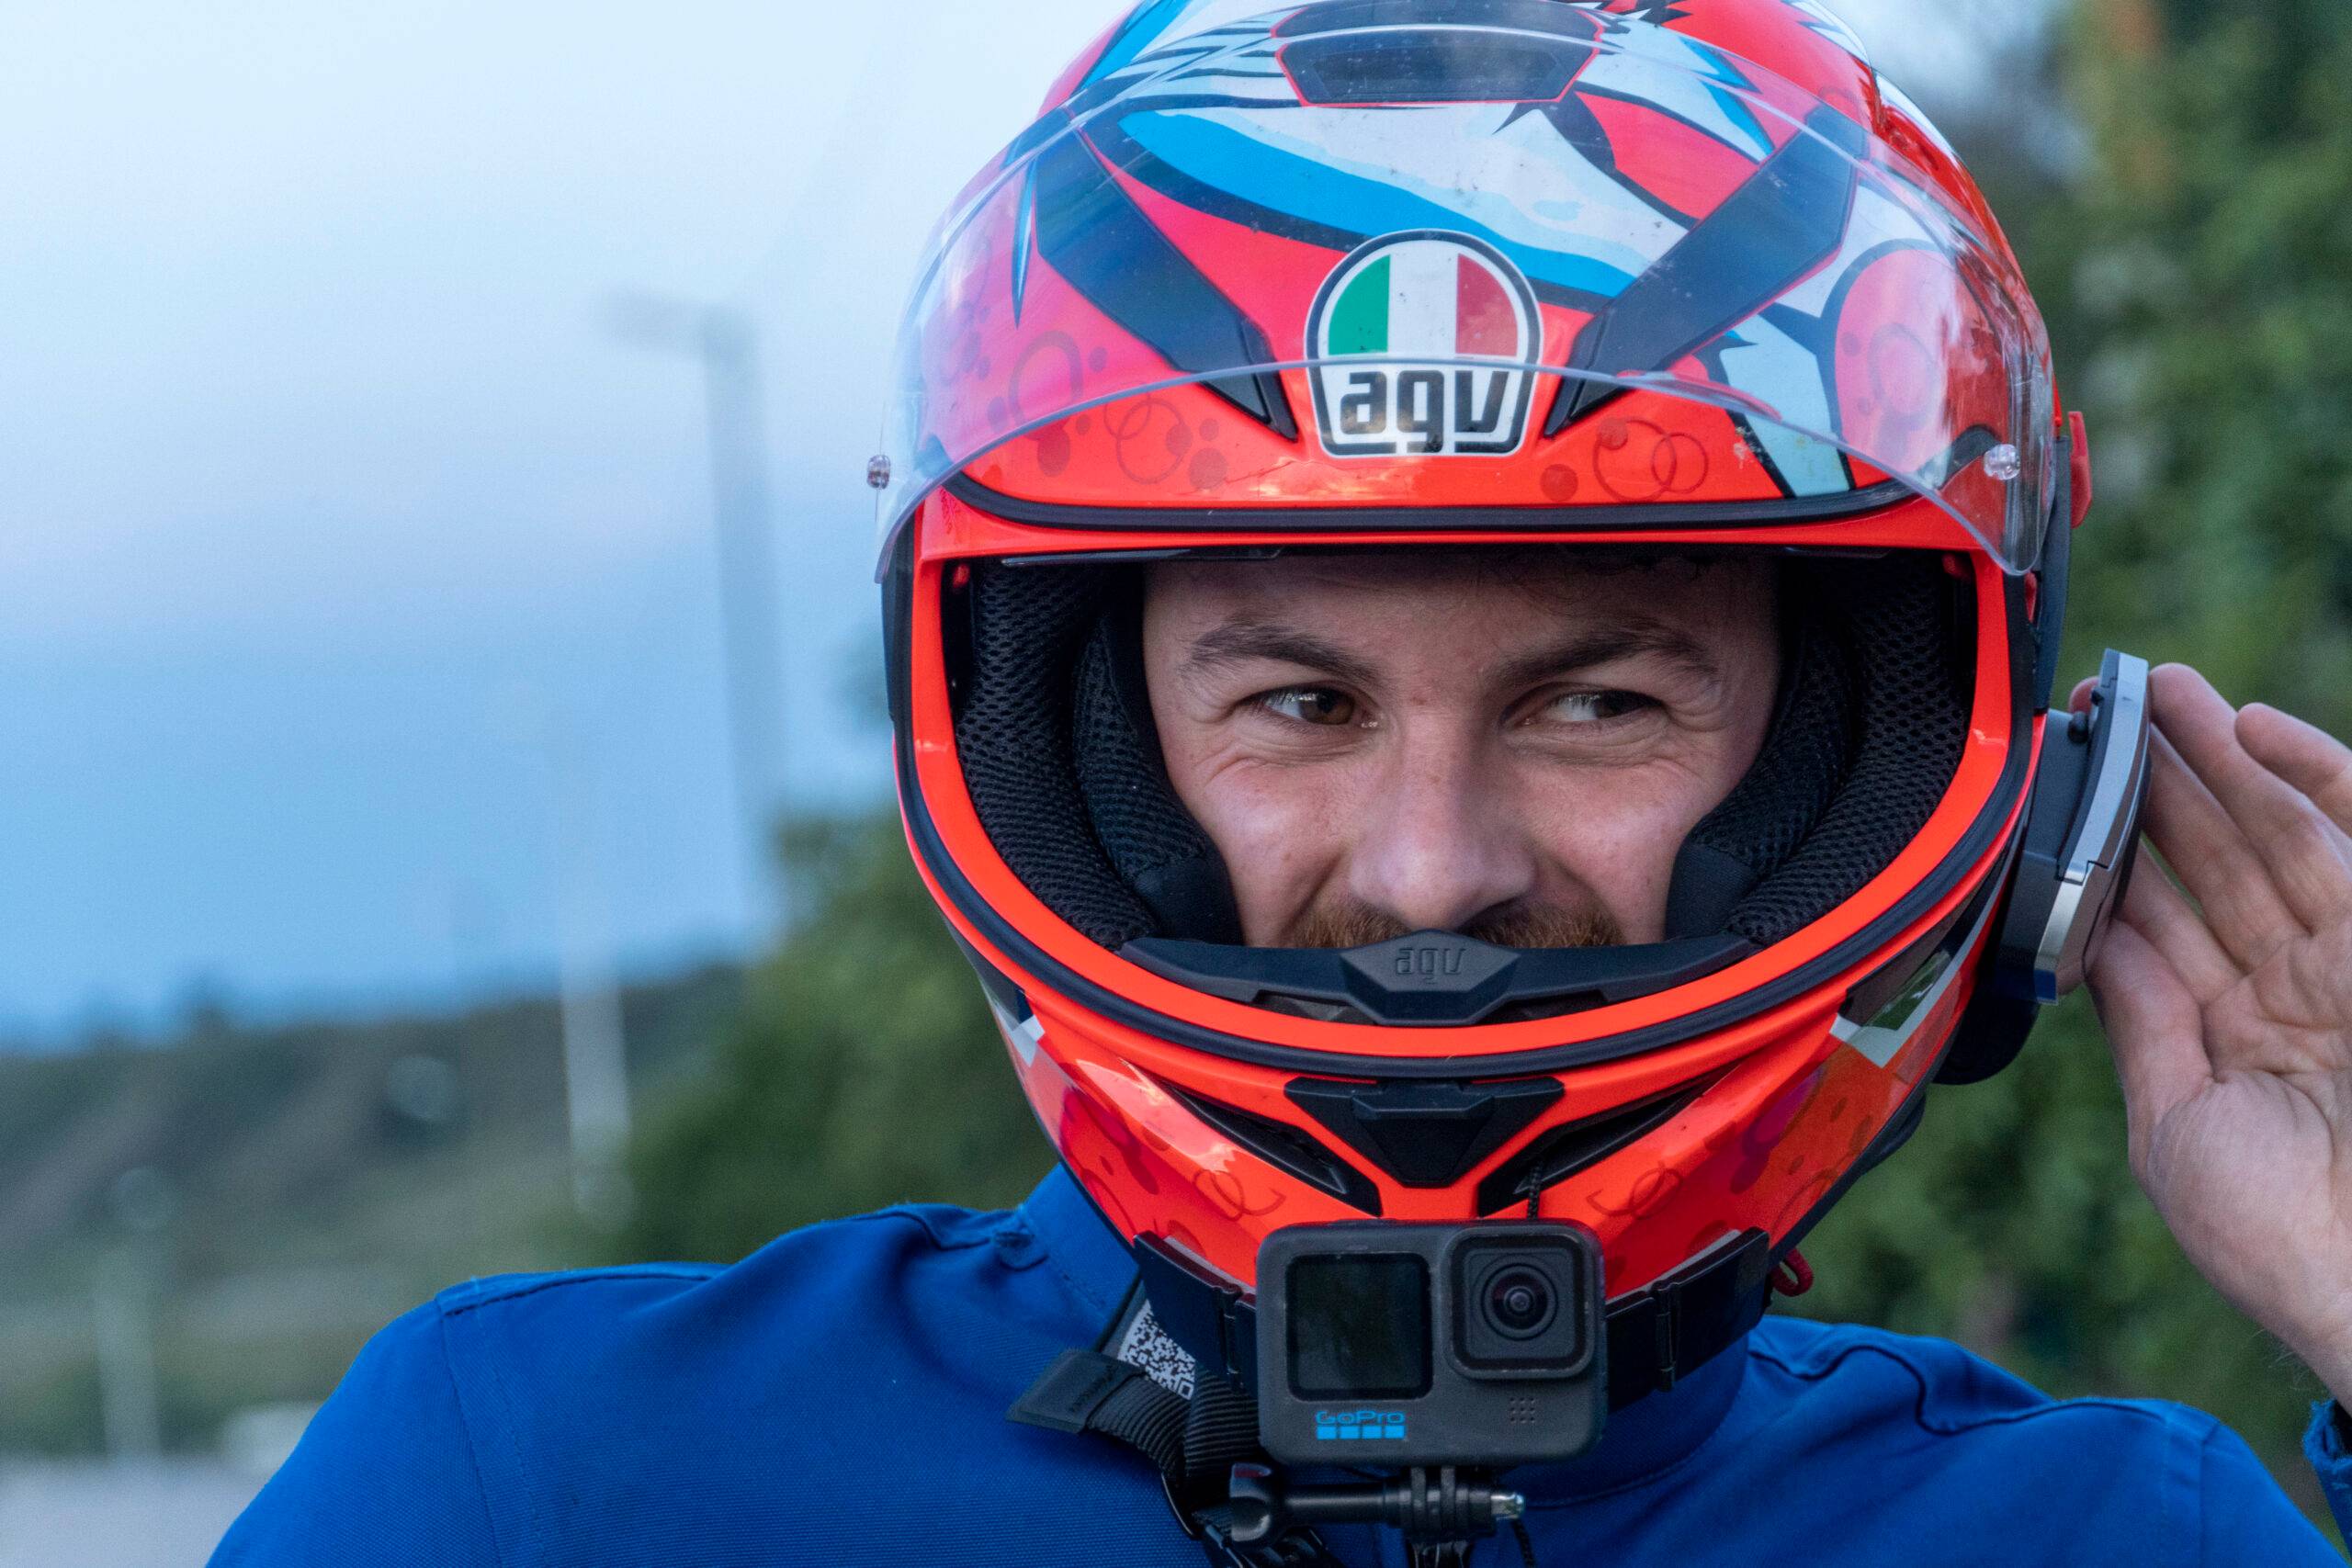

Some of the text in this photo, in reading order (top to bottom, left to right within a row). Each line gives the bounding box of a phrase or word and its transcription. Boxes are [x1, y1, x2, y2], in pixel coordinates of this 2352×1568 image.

[1340, 370, 1510, 453] agv
[1395, 947, 1466, 985] agv
[1316, 1410, 1406, 1425] GoPro
